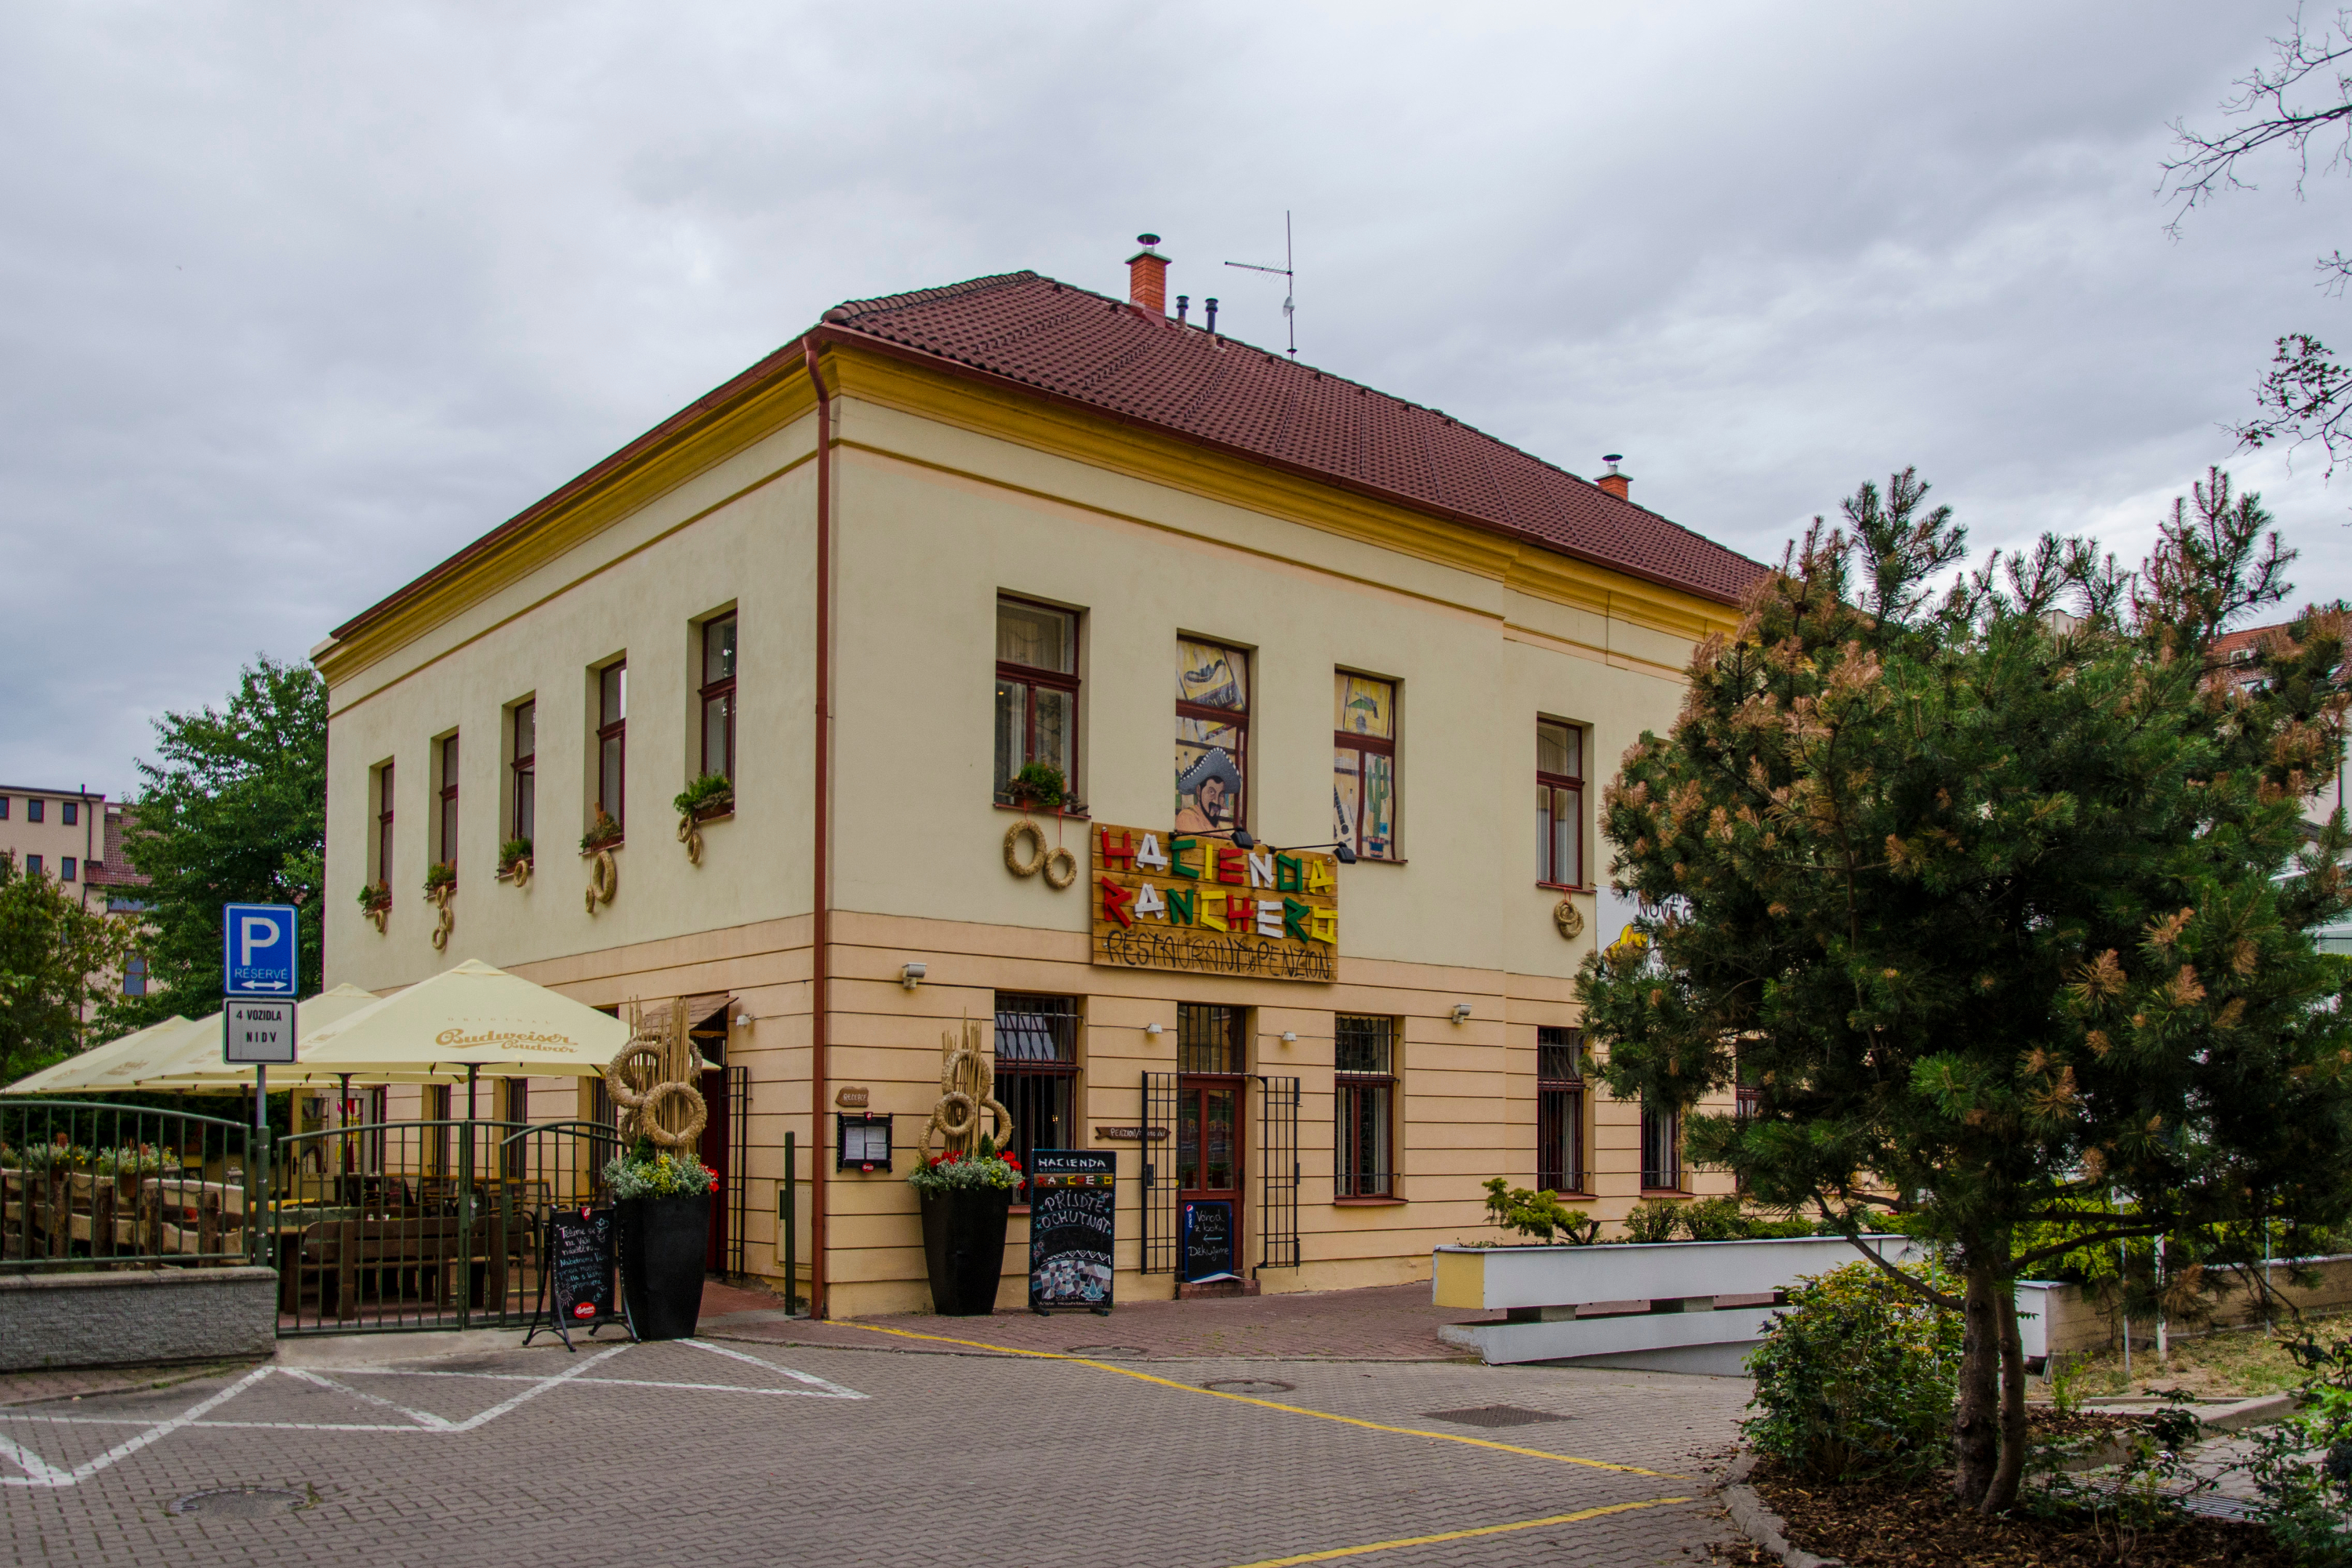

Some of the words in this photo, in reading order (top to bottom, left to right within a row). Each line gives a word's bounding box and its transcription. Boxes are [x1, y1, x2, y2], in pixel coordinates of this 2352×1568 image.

[1102, 829, 1335, 894] HACIENDA
[1100, 876, 1338, 944] RANCHERO
[241, 917, 280, 966] P
[1107, 930, 1247, 973] RESTAURANT
[1257, 941, 1331, 980] PENZION
[234, 967, 289, 979] RÉSERVÉ
[236, 1011, 243, 1021] 4
[247, 1010, 282, 1022] VOZIDLA
[435, 1029, 579, 1048] Budweiser
[502, 1039, 579, 1054] Budvar
[1038, 1158, 1106, 1167] HACIENDA
[1038, 1175, 1113, 1187] RANCHERO
[1041, 1210, 1111, 1233] OCHUTNAT
[1203, 1222, 1226, 1232] boku
